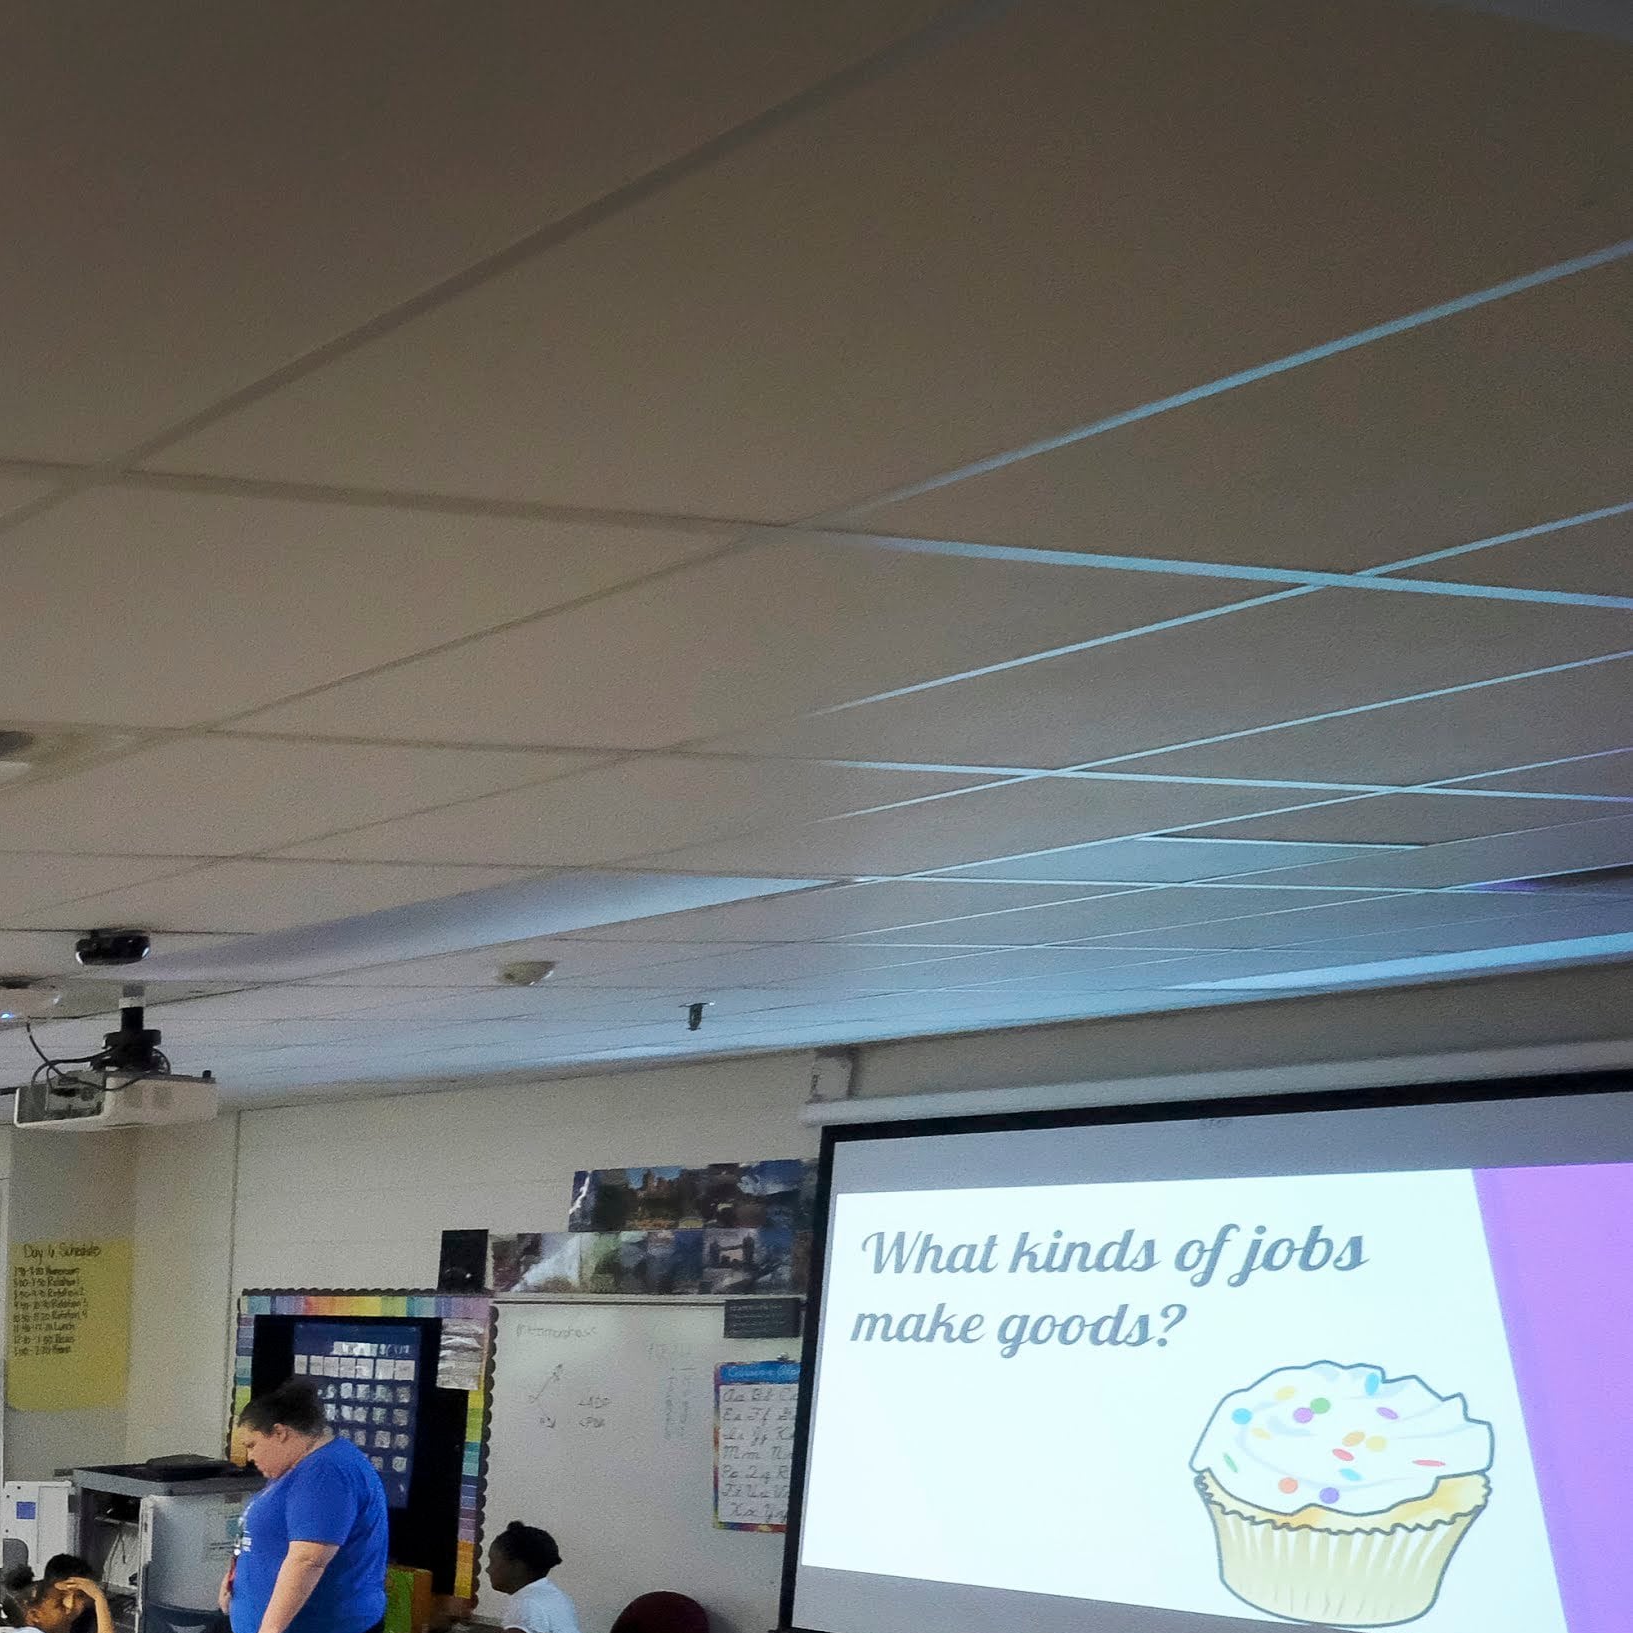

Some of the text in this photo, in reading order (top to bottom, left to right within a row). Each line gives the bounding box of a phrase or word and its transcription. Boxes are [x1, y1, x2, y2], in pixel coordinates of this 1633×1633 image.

[23, 1243, 44, 1266] Day
[861, 1223, 1371, 1289] What kinds of jobs
[849, 1302, 987, 1344] make
[997, 1303, 1188, 1359] goods?
